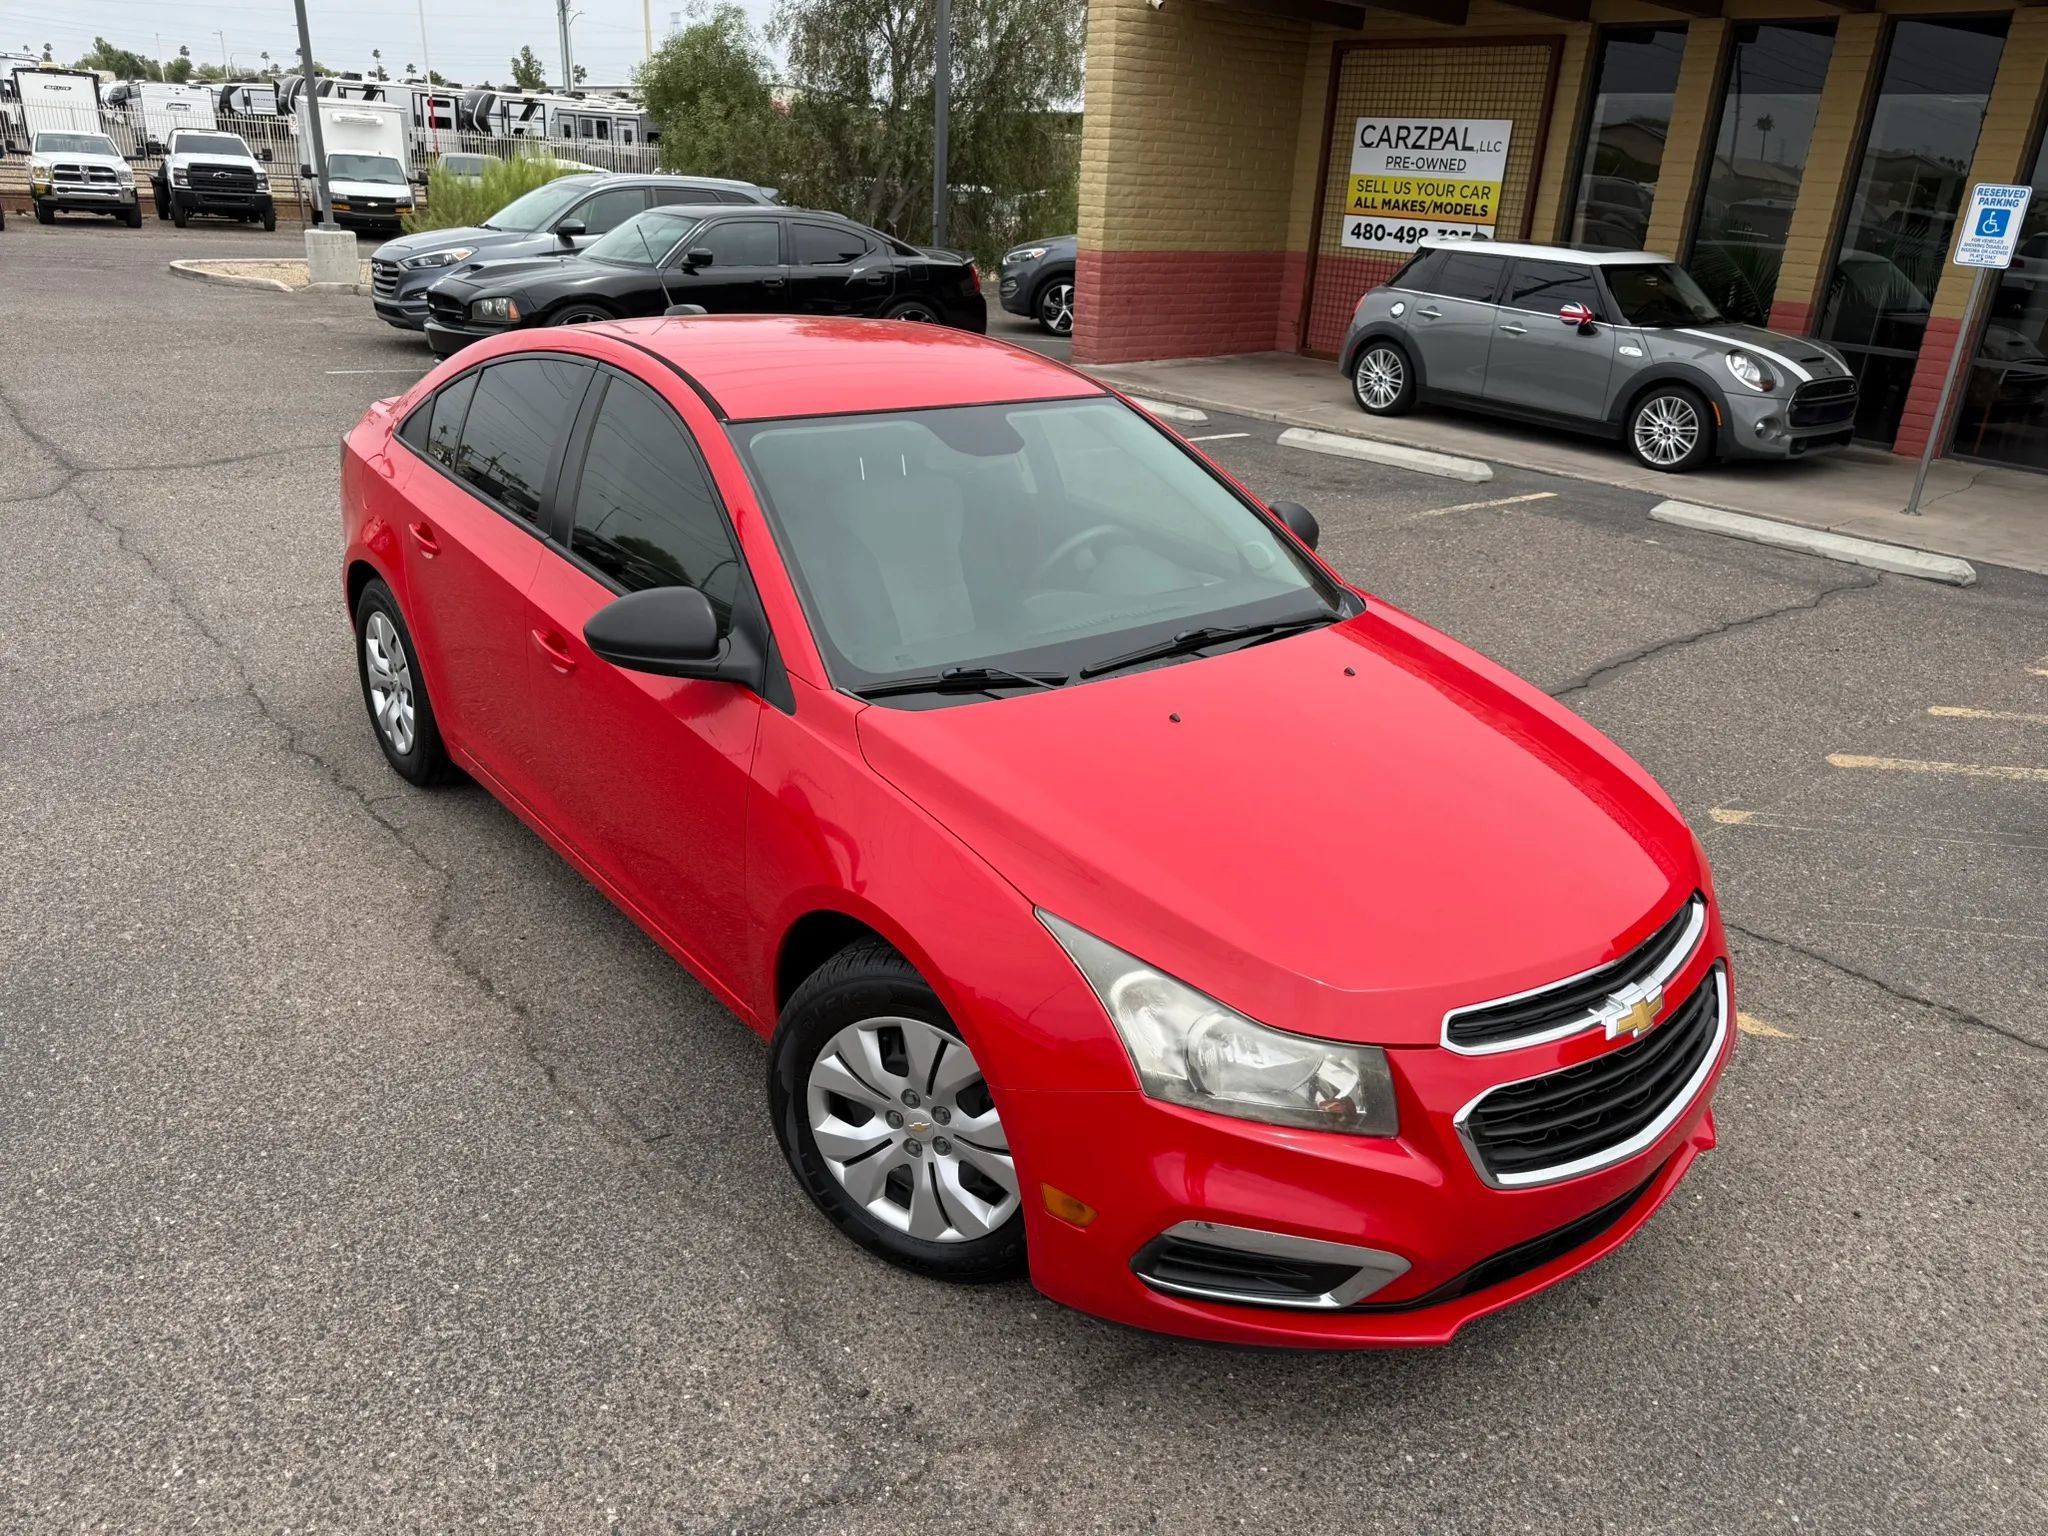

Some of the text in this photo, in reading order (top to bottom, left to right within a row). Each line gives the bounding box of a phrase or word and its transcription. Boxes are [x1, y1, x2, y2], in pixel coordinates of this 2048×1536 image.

[1385, 156, 1467, 172] PRE-OWNED
[1356, 179, 1491, 200] SELL US YOUR CAR
[1977, 188, 2026, 199] RESERVED
[1354, 196, 1488, 217] ALL MAKES/MODELS
[1978, 198, 2019, 208] PARKING
